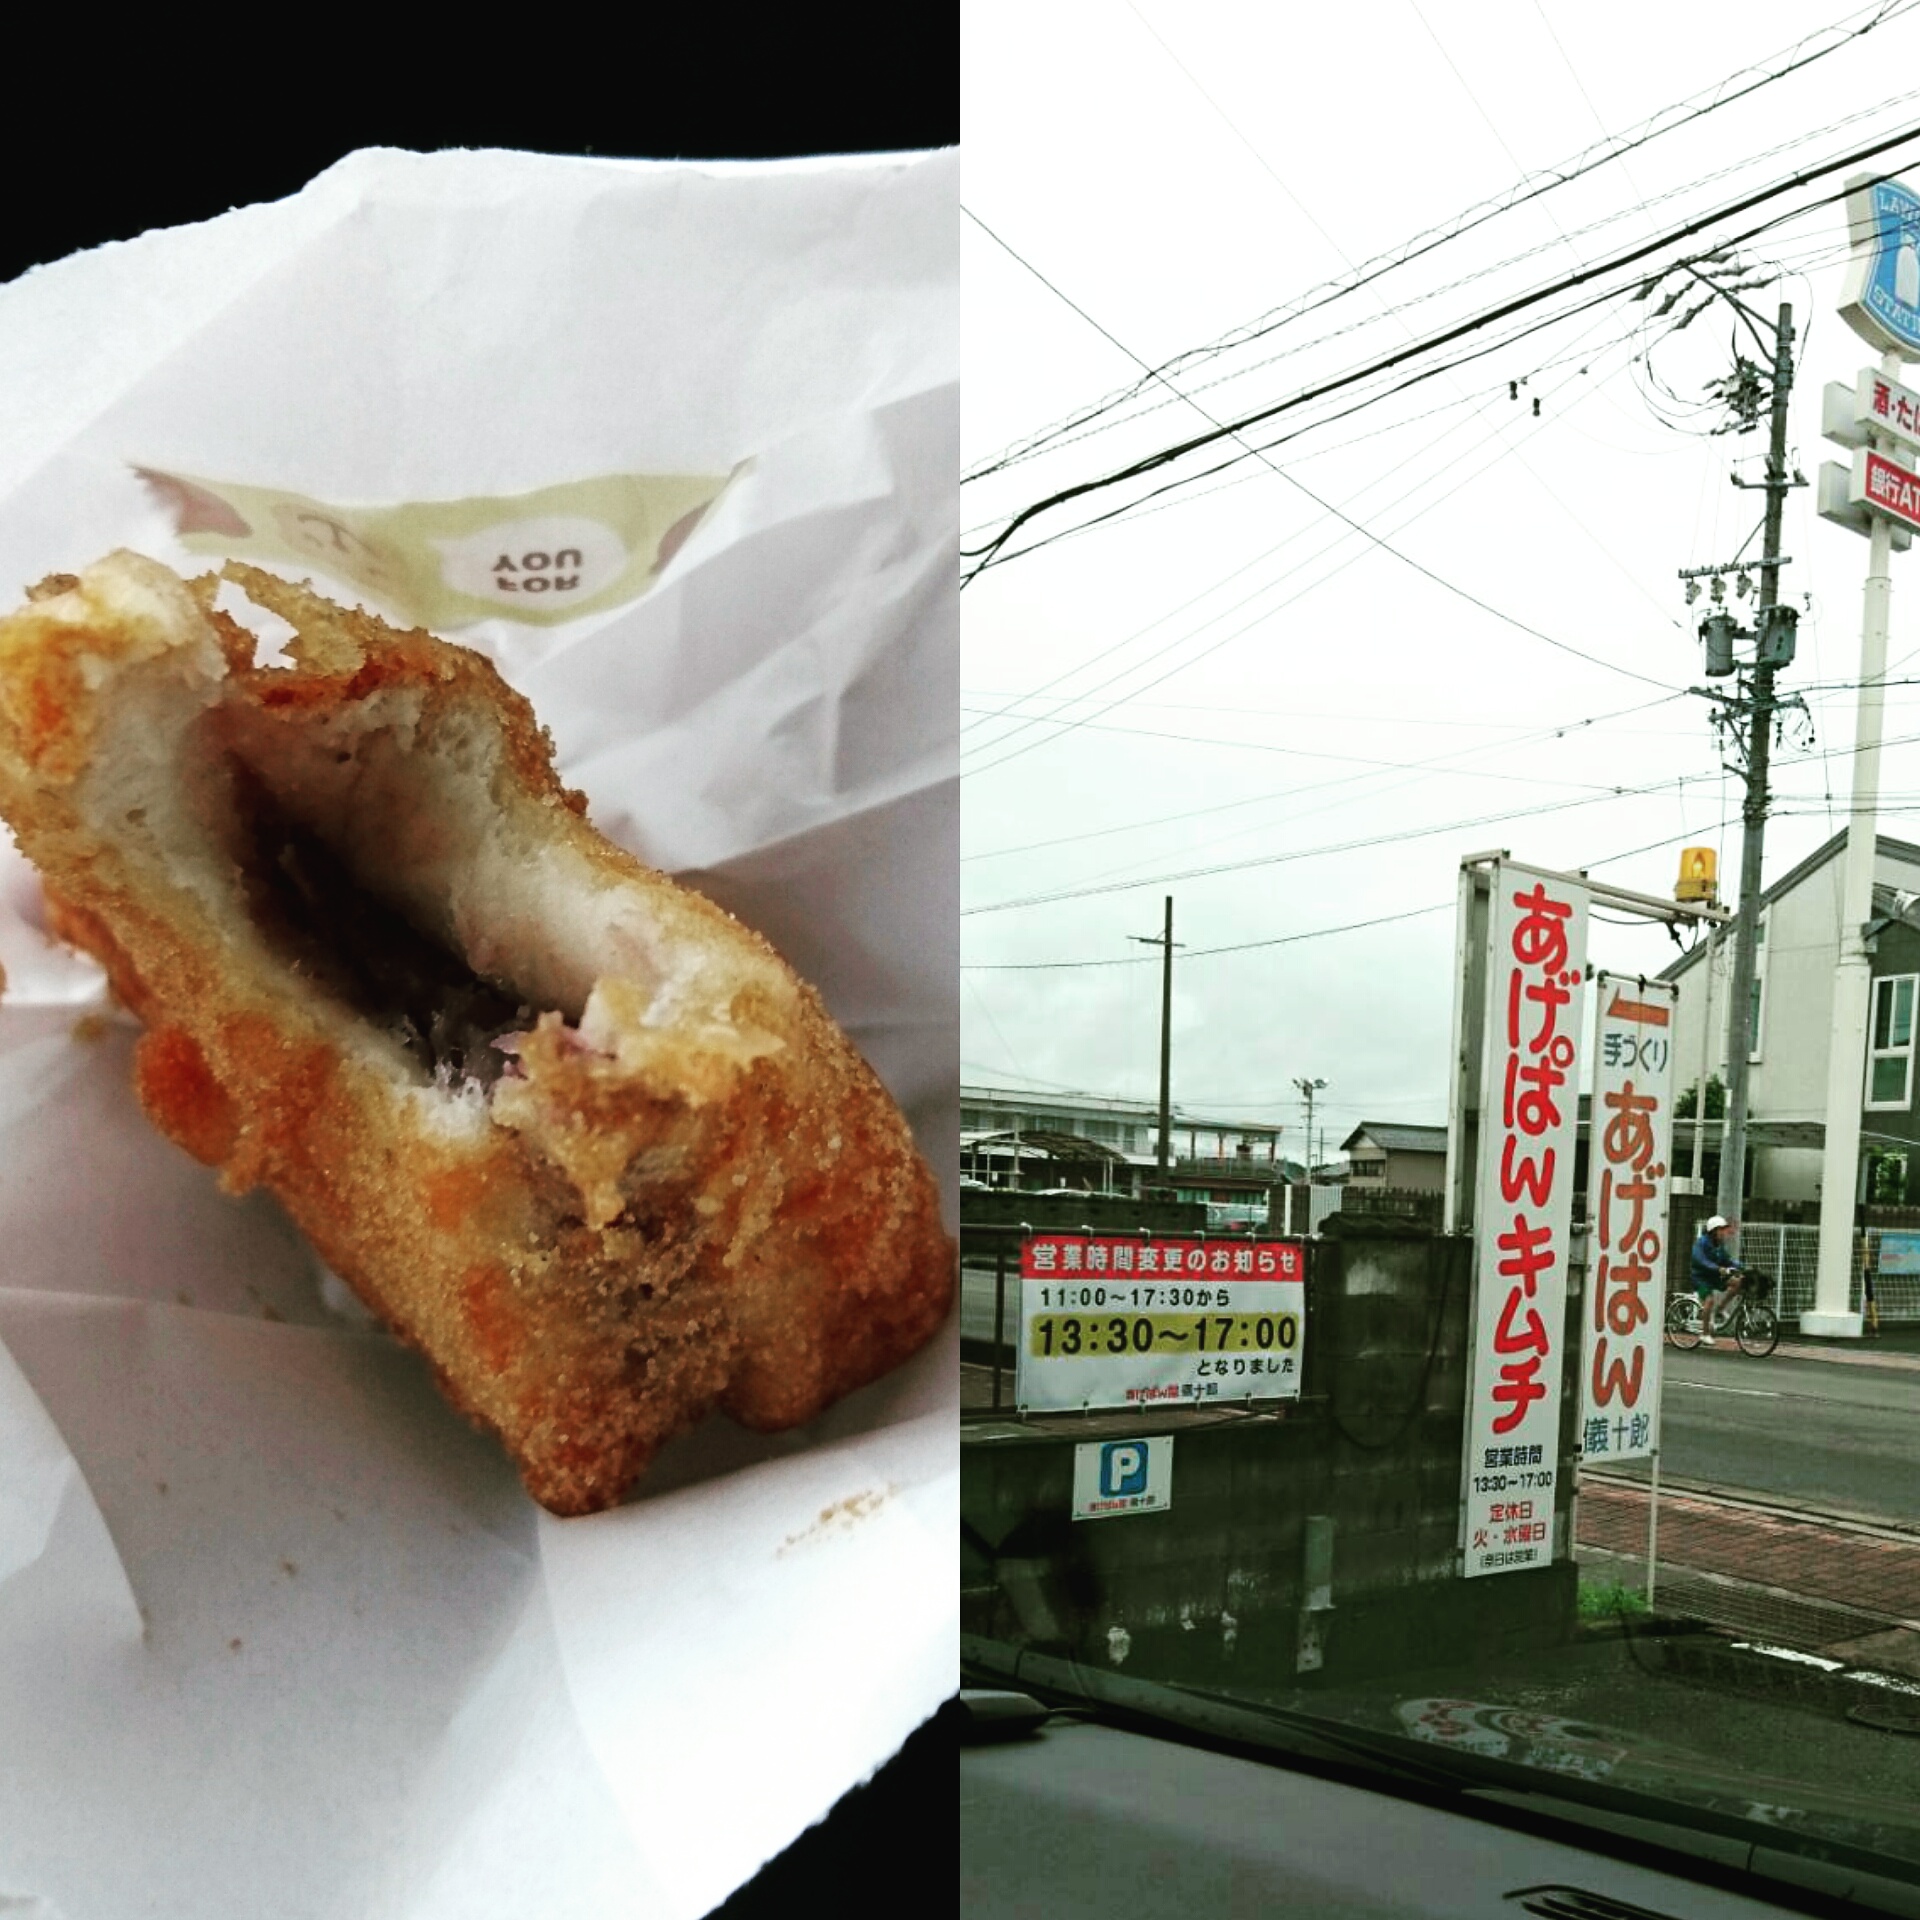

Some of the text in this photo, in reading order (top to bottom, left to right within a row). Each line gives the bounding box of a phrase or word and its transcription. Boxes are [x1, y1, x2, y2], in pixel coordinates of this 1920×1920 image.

[1603, 1032, 1668, 1074] 手づくり
[1491, 882, 1581, 1435] あげぱんキムチ
[1031, 1243, 1297, 1274] 営業時間変更のお知らせ
[1592, 1080, 1666, 1410] あげぱん
[1196, 1357, 1295, 1377] となりました
[1110, 1447, 1141, 1491] P
[1484, 1445, 1543, 1469] 営業時間
[1489, 1501, 1533, 1524] 定休日
